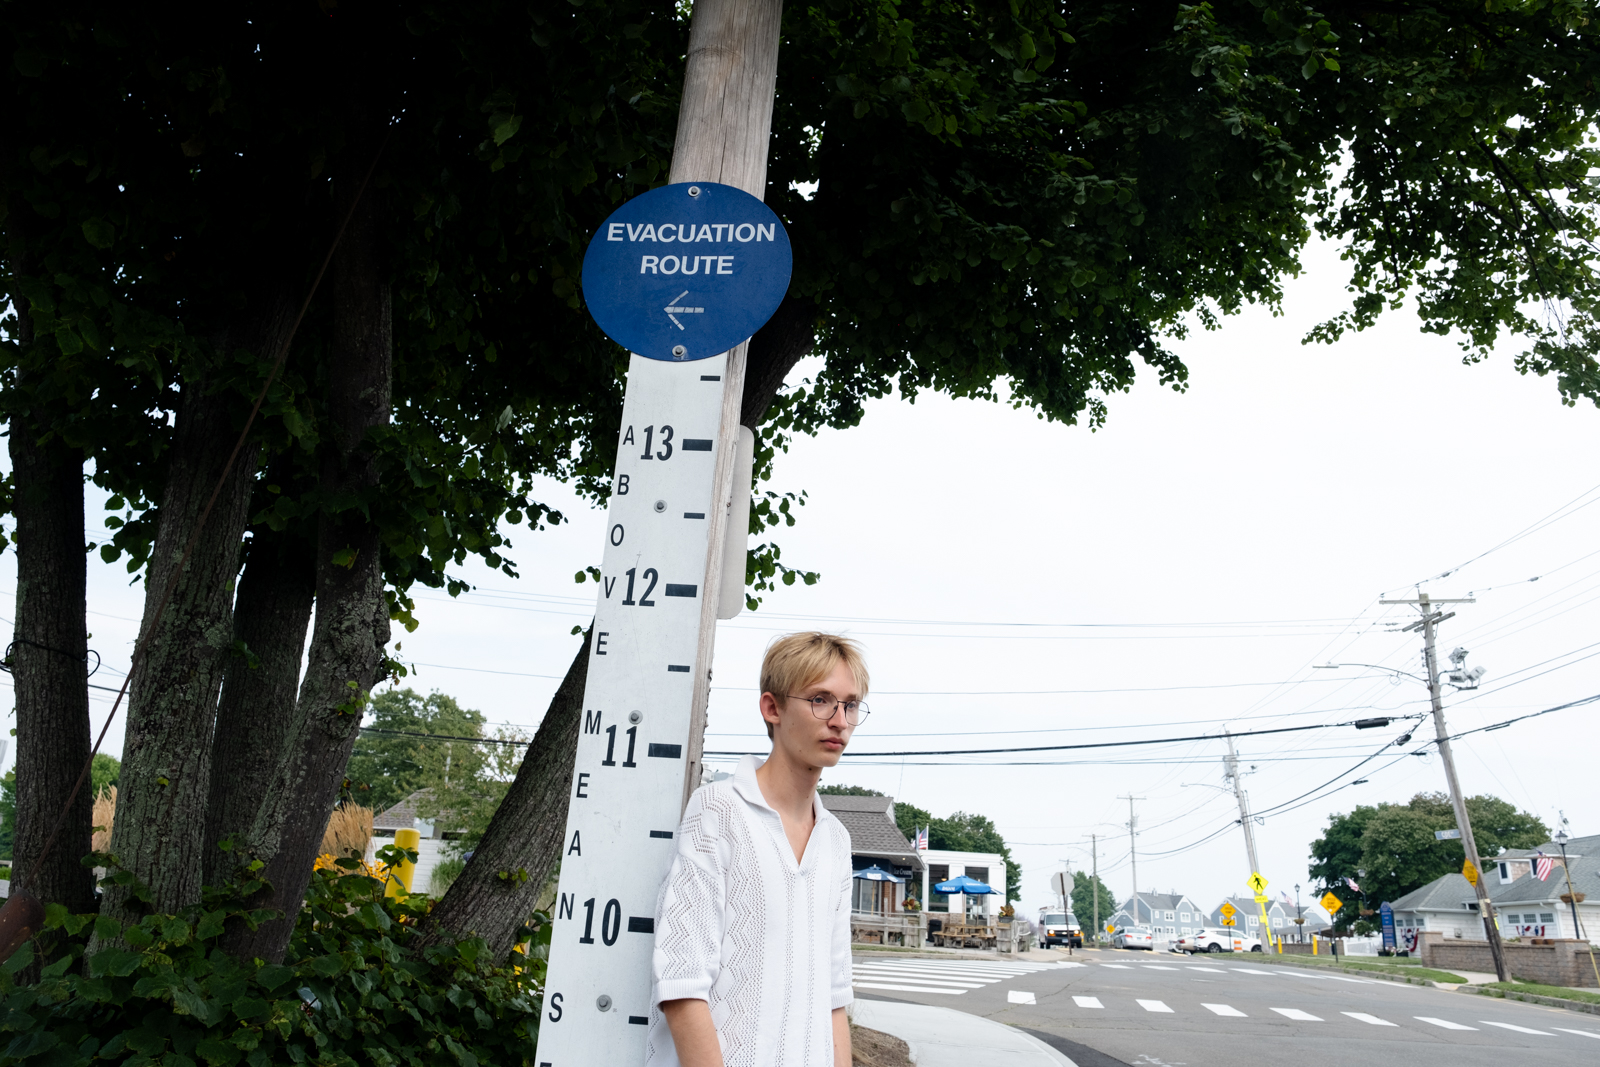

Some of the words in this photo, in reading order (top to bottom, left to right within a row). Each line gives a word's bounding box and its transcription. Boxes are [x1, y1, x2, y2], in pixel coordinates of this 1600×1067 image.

[607, 222, 776, 243] EVACUATION
[640, 255, 735, 275] ROUTE
[640, 425, 674, 461] 13
[622, 567, 659, 607] 12
[602, 724, 638, 768] 11
[579, 897, 622, 947] 10
